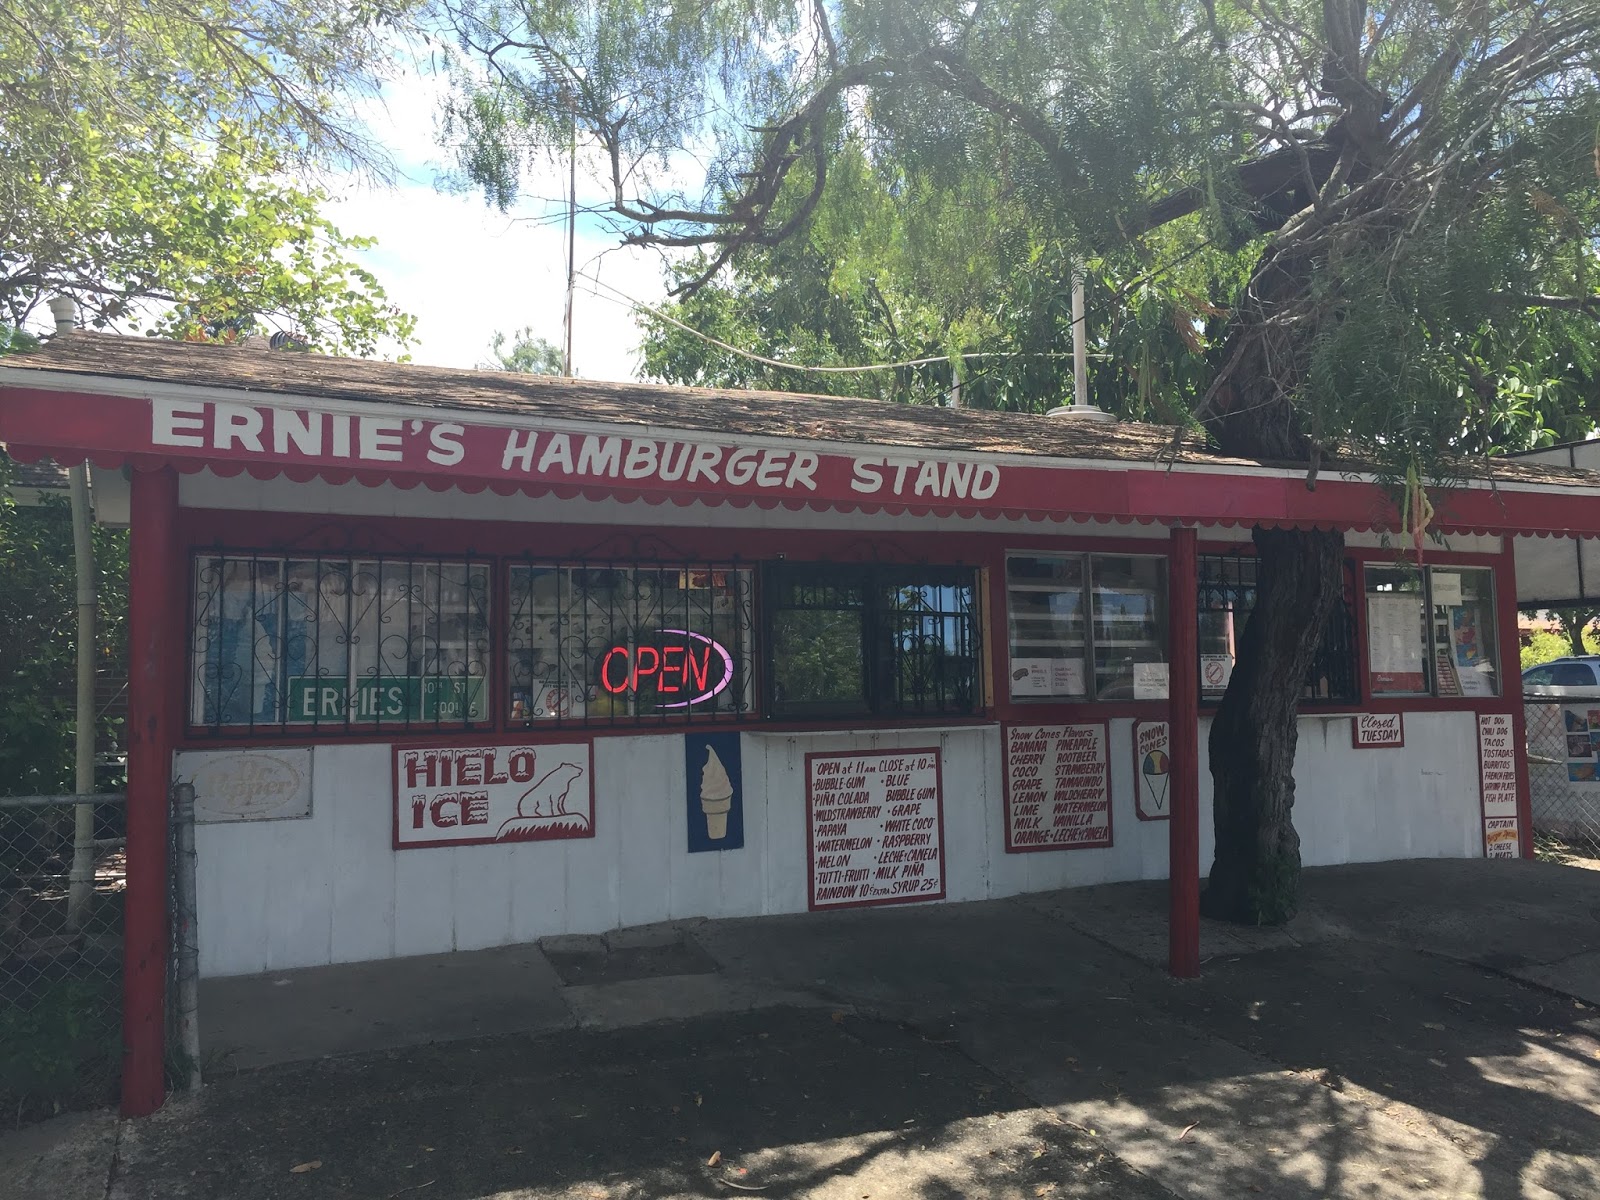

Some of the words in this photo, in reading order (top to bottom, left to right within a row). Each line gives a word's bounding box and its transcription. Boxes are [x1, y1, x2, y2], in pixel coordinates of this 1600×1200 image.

[152, 401, 465, 466] ERNIE'S
[501, 429, 819, 491] HAMBURGER
[850, 457, 999, 500] STAND
[602, 647, 710, 693] OPEN
[1361, 715, 1396, 729] Closed
[1481, 716, 1492, 725] HOT
[1494, 716, 1505, 725] DOG
[1011, 728, 1032, 740] Snow
[1035, 728, 1060, 739] Cones
[1063, 726, 1094, 738] Flavors
[1139, 723, 1165, 744] SNOW
[1361, 729, 1399, 742] TUESDAY
[1496, 727, 1508, 735] DOG
[1011, 740, 1047, 753] BANANA
[1056, 737, 1098, 751] PINEAPPLE
[1140, 736, 1167, 755] CONES
[1484, 738, 1505, 747] TACOS
[1010, 754, 1045, 765] CHERRY
[1057, 751, 1097, 763] ROOTBEER
[1483, 749, 1514, 758] TOSTADAS
[404, 747, 536, 788] HIELO
[817, 762, 841, 775] OPEN
[842, 762, 852, 774] at
[855, 761, 865, 773] 11
[879, 759, 904, 772] CLOSE
[904, 759, 915, 771] at
[917, 758, 927, 770] 10
[1055, 762, 1105, 776] STRAWBERRY
[1484, 760, 1510, 769] BURRITOS
[1012, 766, 1038, 777] COCO
[1484, 771, 1502, 780] FRENCH
[886, 773, 910, 787] BLUE
[1013, 779, 1043, 791] GRAPE
[1055, 776, 1102, 788] TAMARINDO
[1500, 781, 1515, 791] PLATE
[815, 792, 835, 806] PIÑA
[837, 791, 869, 805] COLADA
[886, 788, 916, 802] BUBBLE
[917, 787, 935, 800] GUM
[1013, 791, 1048, 804] LEMON
[1484, 793, 1496, 803] FISH
[1497, 793, 1514, 802] PLATE
[412, 791, 489, 829] ICE
[891, 803, 921, 816] GRAPE
[1014, 804, 1039, 816] LIME
[1053, 801, 1107, 814] WATERMELON
[884, 818, 911, 832] WHITE
[912, 817, 934, 830] COCO
[1014, 817, 1043, 829] MILK
[1487, 819, 1514, 829] CAPTAIN
[816, 823, 847, 837] PAPAYA
[882, 833, 931, 849] RASPBERRY
[1014, 830, 1050, 844] ORANGE
[817, 837, 873, 852] WATERMELON
[1494, 842, 1512, 850] CHEESE
[818, 854, 851, 869] MELON
[1495, 851, 1513, 859] MEATS
[875, 866, 900, 880] MILK
[901, 861, 924, 878] PIÑA
[816, 885, 858, 900] RAINBOW
[873, 888, 890, 896] EXTRA
[891, 880, 920, 894] SYRUP
